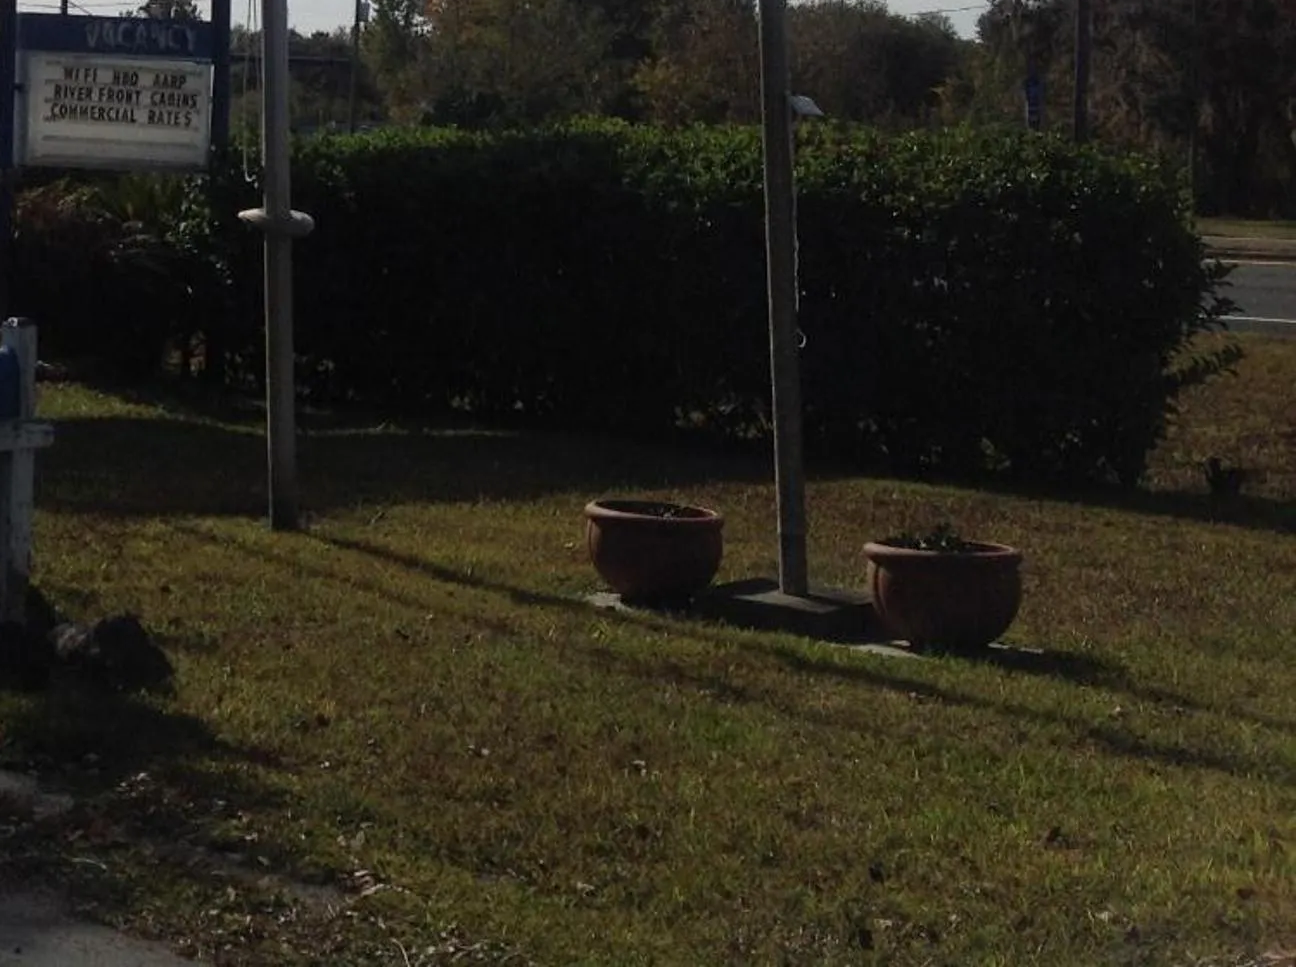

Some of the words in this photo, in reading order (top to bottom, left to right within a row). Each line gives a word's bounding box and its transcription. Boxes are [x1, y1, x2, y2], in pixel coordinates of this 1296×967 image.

[86, 20, 197, 51] VACANCY
[112, 69, 139, 86] HBO
[152, 72, 187, 90] AARP
[150, 90, 198, 109] CABINS
[50, 102, 137, 124] COMMERCIAL
[147, 108, 193, 128] RATES
